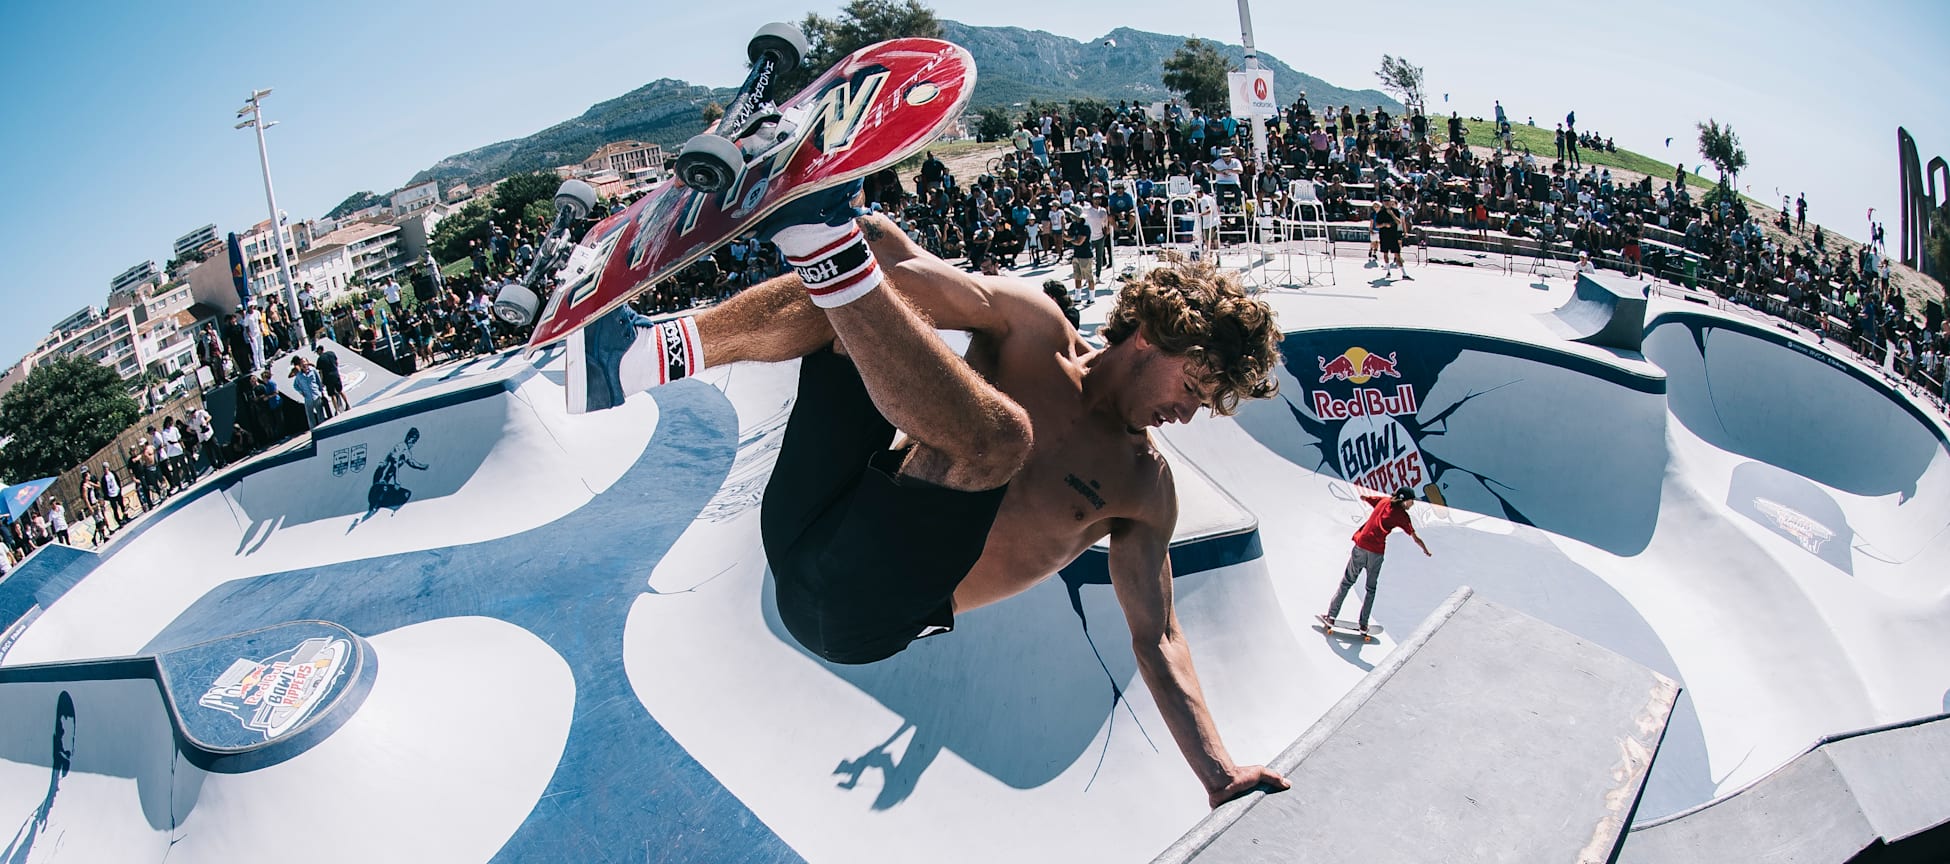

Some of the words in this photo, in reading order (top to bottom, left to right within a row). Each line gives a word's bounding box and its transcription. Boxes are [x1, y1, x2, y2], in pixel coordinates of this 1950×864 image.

[794, 259, 838, 282] HOA
[1312, 388, 1364, 420] Red
[1364, 384, 1417, 417] Bull
[1341, 421, 1406, 480] BOWL
[245, 682, 270, 704] Red
[263, 661, 289, 682] Bull
[268, 670, 296, 704] BOWL
[283, 665, 312, 704] RIPPERS
